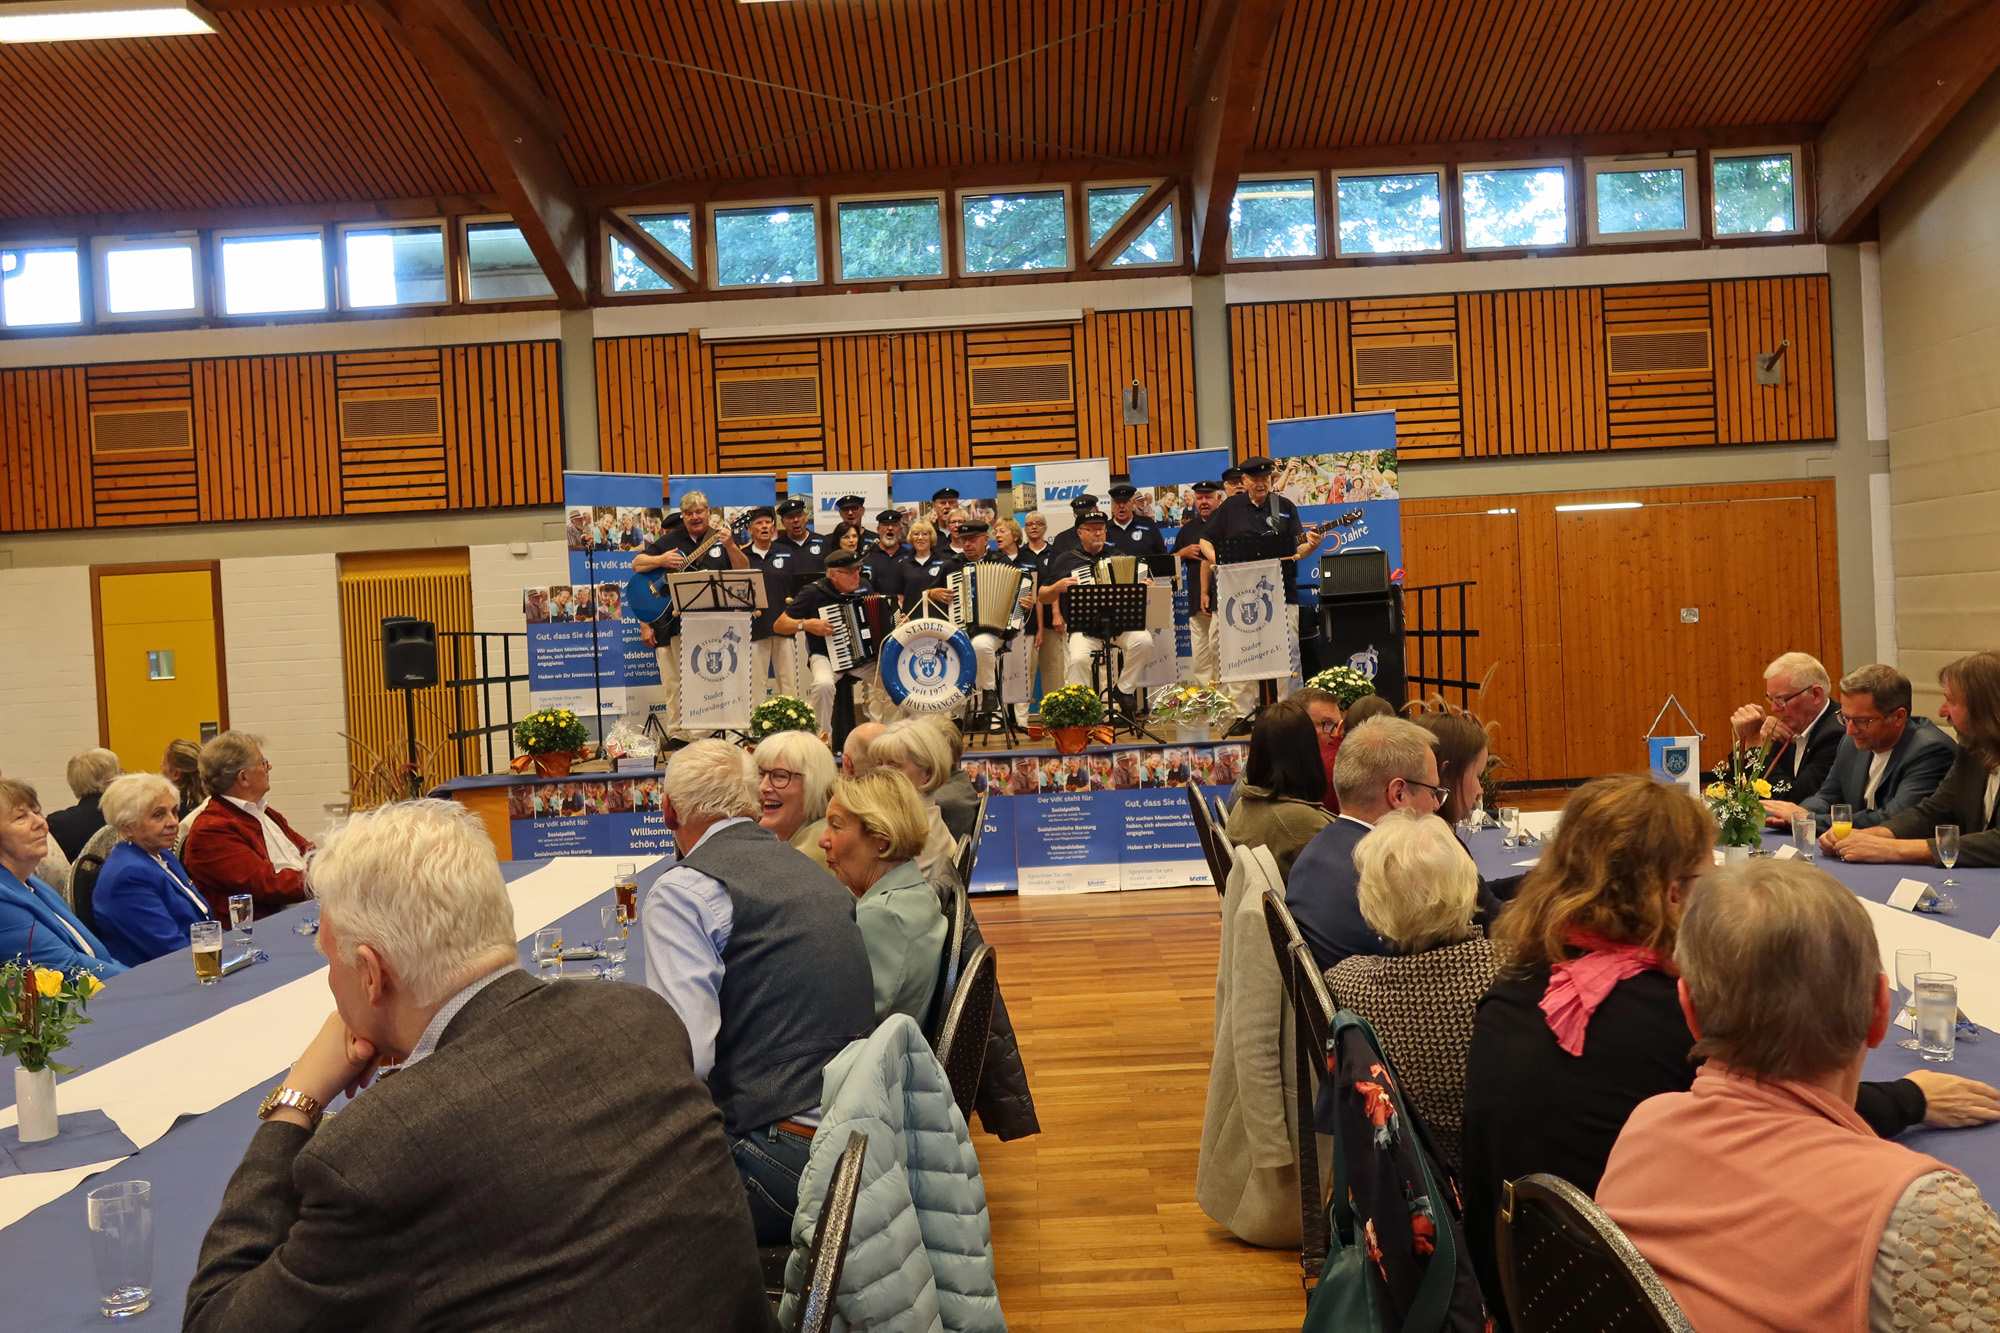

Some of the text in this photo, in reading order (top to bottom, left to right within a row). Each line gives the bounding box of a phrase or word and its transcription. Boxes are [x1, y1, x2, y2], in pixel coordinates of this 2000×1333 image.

[1045, 485, 1088, 500] VdK
[1340, 526, 1369, 545] Jahre
[601, 561, 618, 569] VdK
[906, 622, 943, 636] STADER
[1240, 641, 1262, 653] Stader
[624, 651, 654, 660] dsleben
[1228, 650, 1269, 670] Hafensänger
[912, 684, 948, 696] seit 1977
[703, 691, 724, 702] Stader
[689, 700, 730, 717] Hafensänger
[630, 828, 672, 836] Willkomm
[630, 839, 674, 849] schön, das
